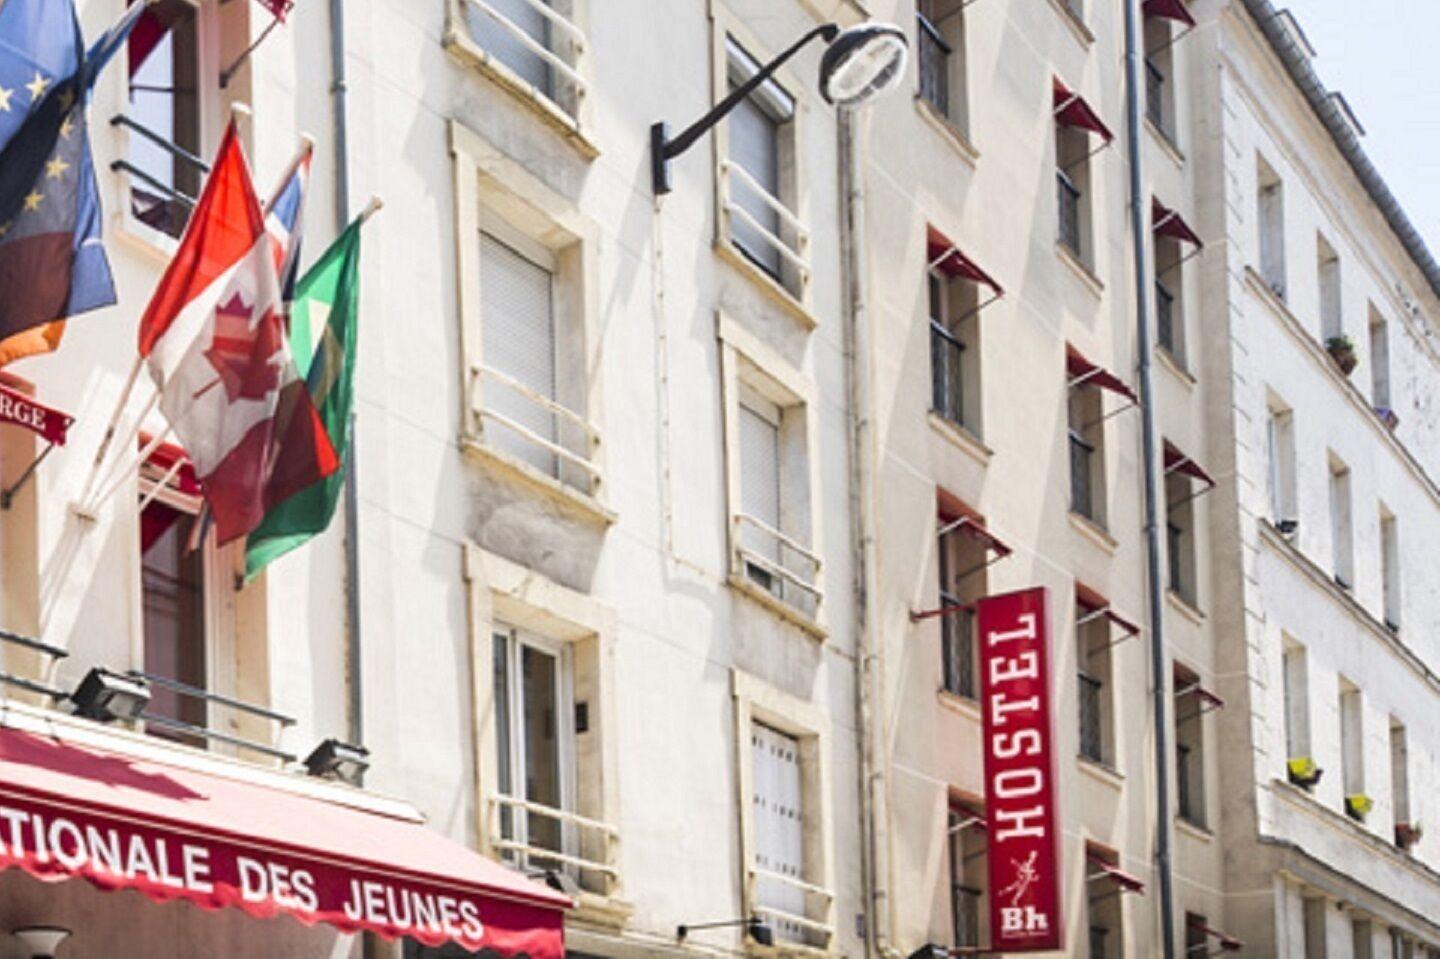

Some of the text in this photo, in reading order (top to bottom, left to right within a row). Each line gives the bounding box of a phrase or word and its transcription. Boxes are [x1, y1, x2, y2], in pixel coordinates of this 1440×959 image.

[988, 613, 1046, 843] HOSTEL
[236, 856, 319, 913] DES
[343, 879, 486, 941] JEUNES
[1001, 905, 1049, 930] Bh
